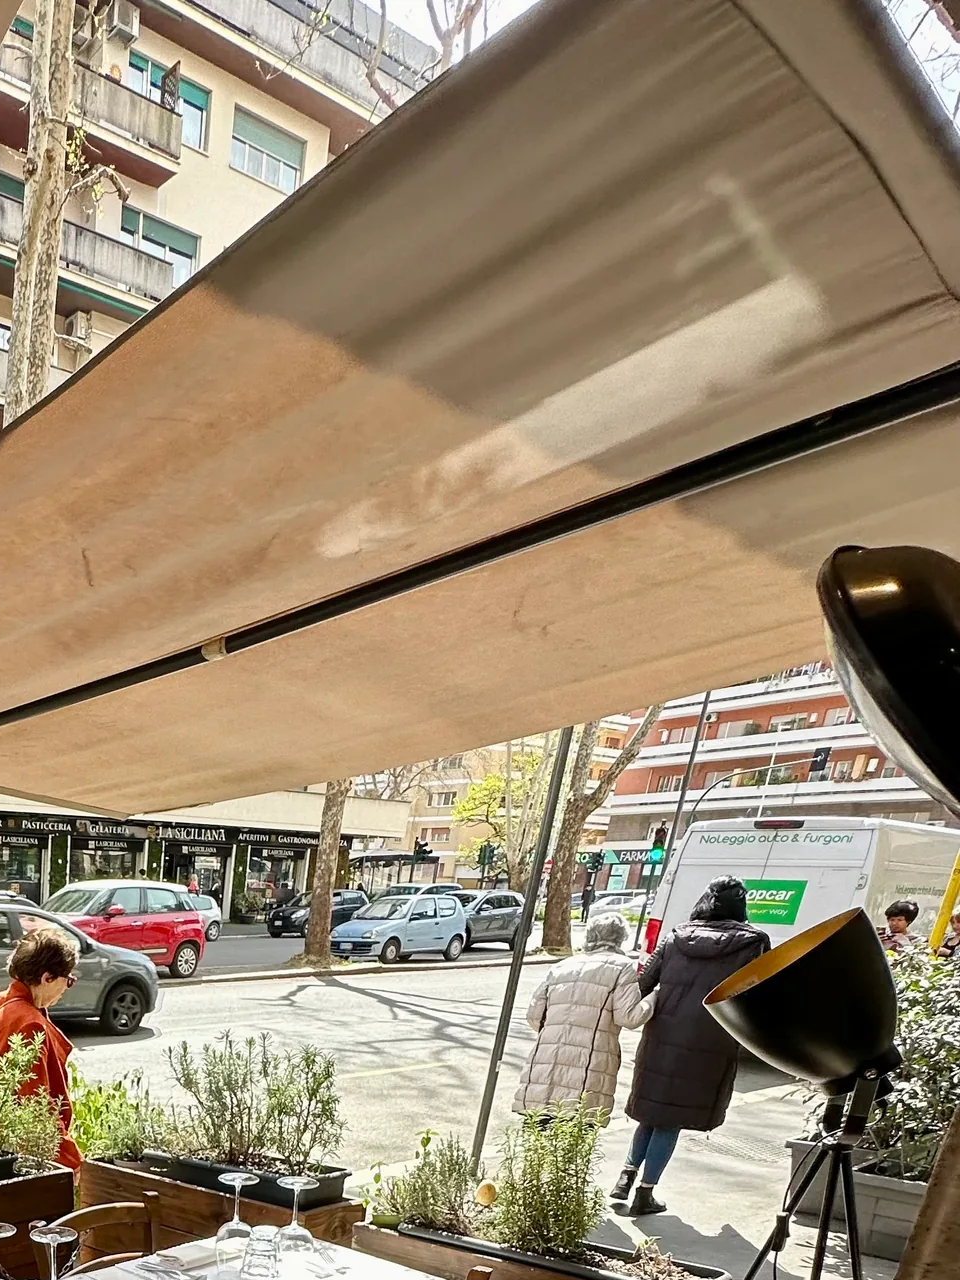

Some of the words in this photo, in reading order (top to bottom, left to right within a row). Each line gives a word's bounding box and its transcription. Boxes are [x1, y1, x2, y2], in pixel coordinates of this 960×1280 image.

[22, 819, 72, 832] PASTICCERIA
[90, 823, 130, 835] GELATERIA
[159, 826, 173, 838] LA
[175, 827, 226, 841] SICILIANA
[238, 833, 269, 842] APERITIVI
[791, 833, 800, 843] &
[619, 851, 665, 862] FARMA
[746, 890, 795, 905] opcar
